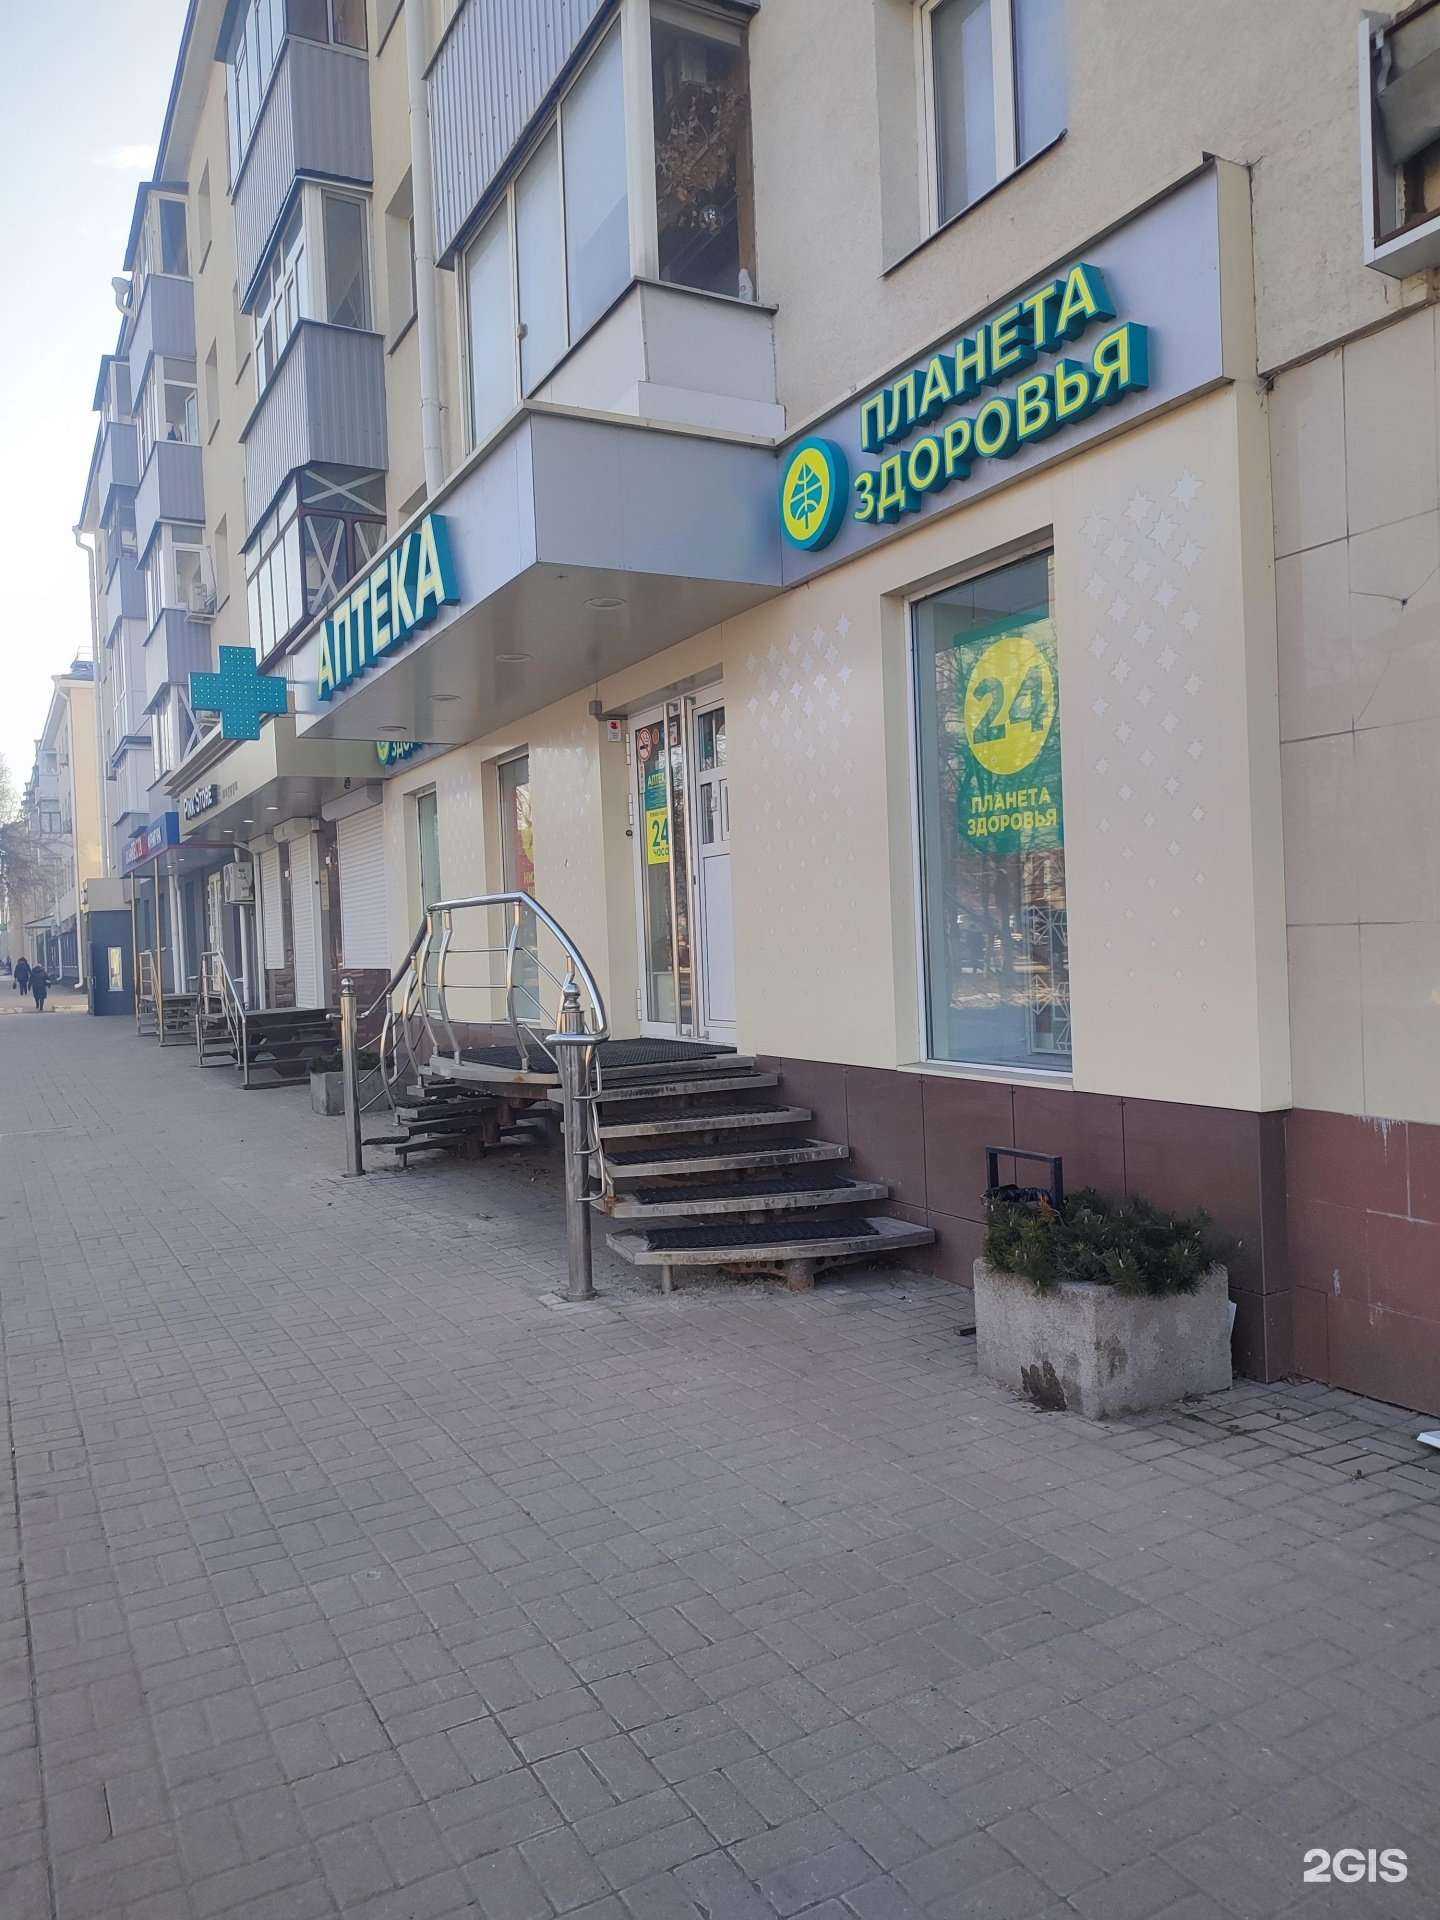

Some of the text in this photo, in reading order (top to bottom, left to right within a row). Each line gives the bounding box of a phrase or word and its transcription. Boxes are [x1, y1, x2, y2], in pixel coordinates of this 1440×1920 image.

[859, 263, 1106, 451] ПЛАНЕТА
[853, 323, 1138, 523] ЗДОРОВЬЯ
[317, 513, 451, 699] АПТЕКА
[973, 663, 1050, 745] 24
[652, 817, 669, 847] 24
[967, 808, 1057, 837] ЗДОРОВЬЯ
[971, 786, 1050, 814] ПЛАНЕТА
